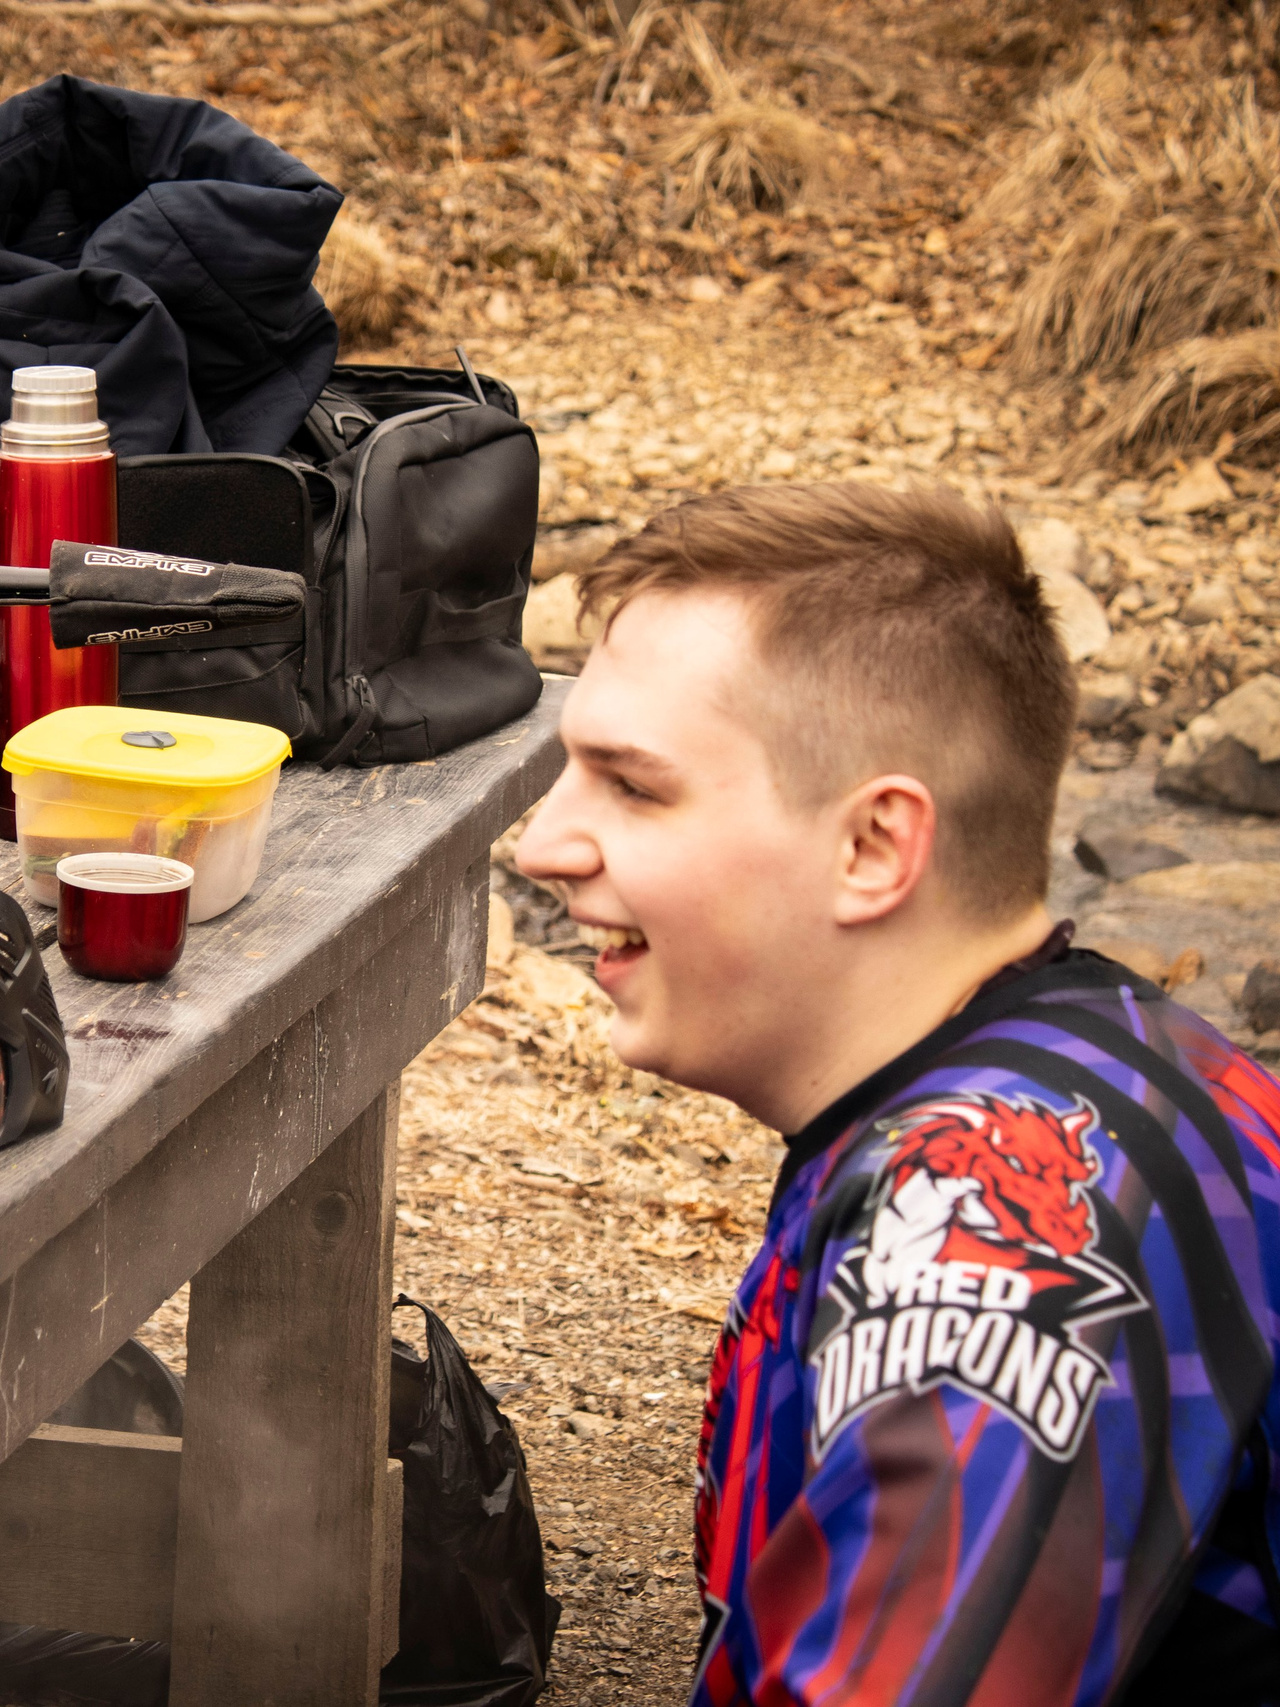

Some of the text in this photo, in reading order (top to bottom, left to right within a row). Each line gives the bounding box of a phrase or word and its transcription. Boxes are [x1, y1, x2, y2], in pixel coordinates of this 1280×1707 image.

[84, 551, 212, 576] EMPIRE
[86, 620, 213, 645] EMPIRE
[896, 1260, 1032, 1311] RED
[819, 1307, 1095, 1447] DRAGONS
